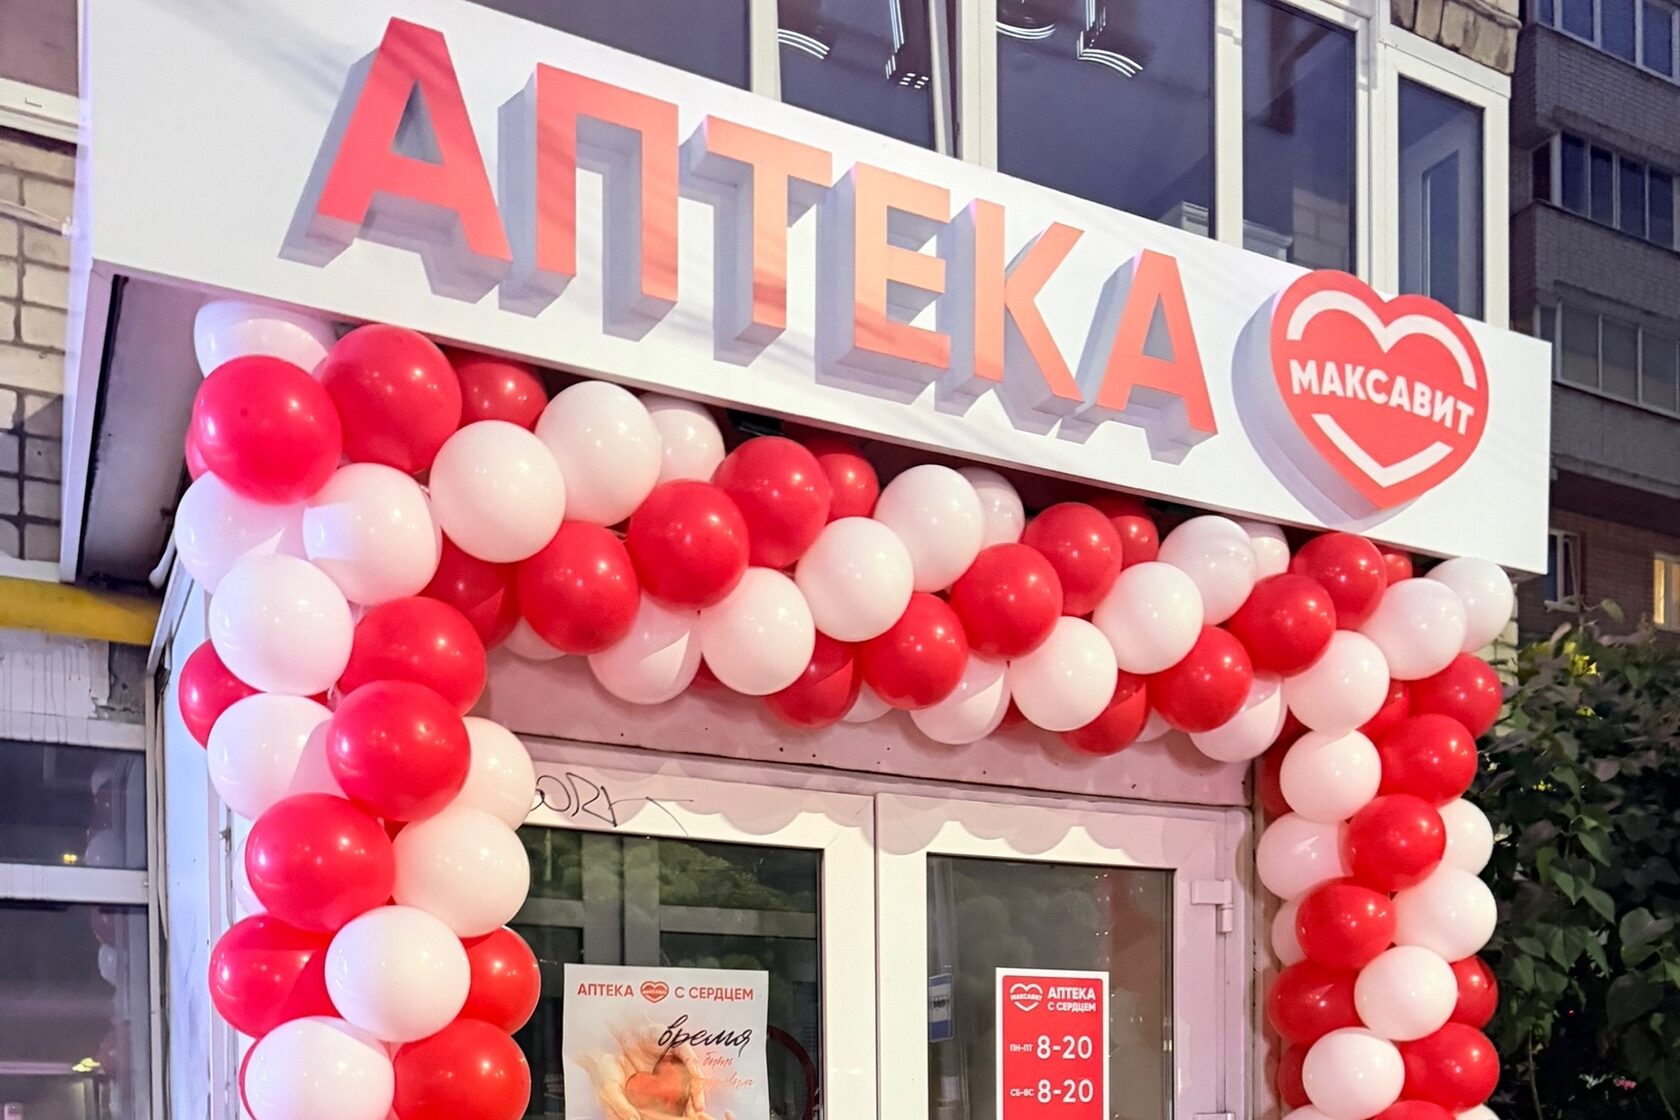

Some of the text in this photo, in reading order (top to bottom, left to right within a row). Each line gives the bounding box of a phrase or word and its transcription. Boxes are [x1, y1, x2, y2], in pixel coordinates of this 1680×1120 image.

[312, 15, 1218, 436] АПТЕКА
[1288, 358, 1475, 436] МАКСАВИТ
[577, 983, 634, 997] АПТЕКА
[674, 986, 685, 999] С
[689, 986, 754, 1001] СЕРДЦЕМ
[1047, 986, 1096, 1000] АПТЕКА
[1047, 1001, 1096, 1013] С СЕРДЦЕМ
[652, 1014, 752, 1076] время
[1009, 1034, 1093, 1060] ПН-ПТ 8-20
[1009, 1079, 1094, 1104] СБ-ВС 8-20
